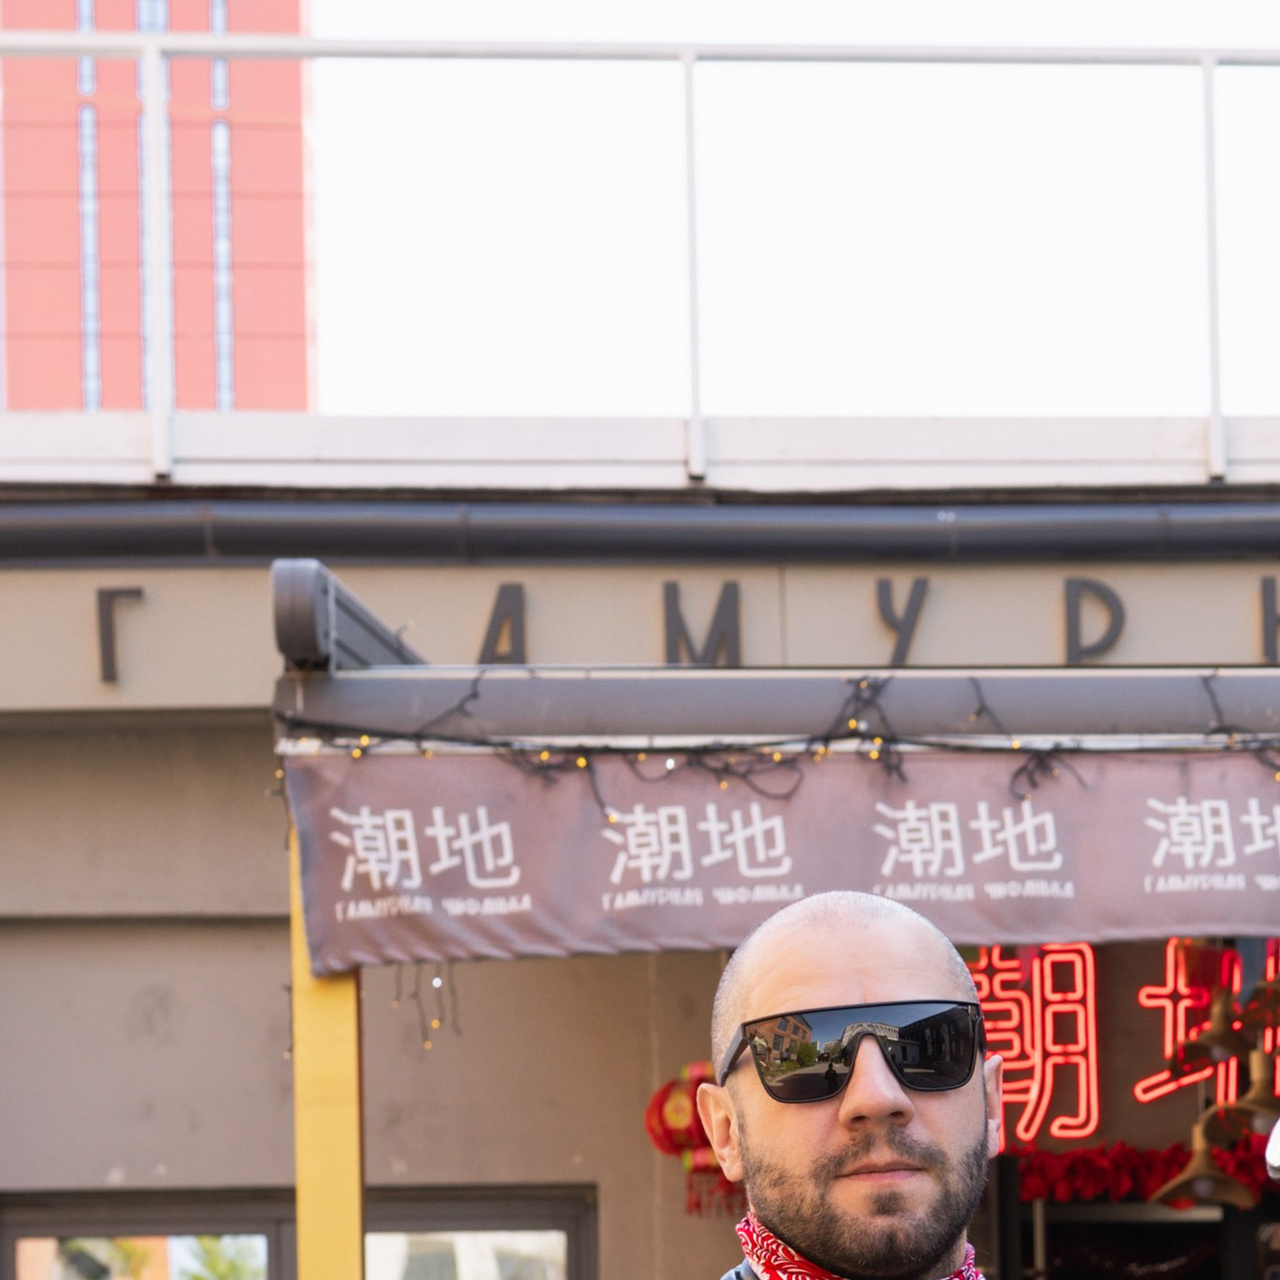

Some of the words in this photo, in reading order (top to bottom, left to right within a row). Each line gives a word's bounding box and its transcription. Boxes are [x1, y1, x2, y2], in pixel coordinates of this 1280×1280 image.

[330, 806, 520, 889] 潮地
[602, 804, 791, 882] 潮地
[872, 801, 1062, 878] 潮地
